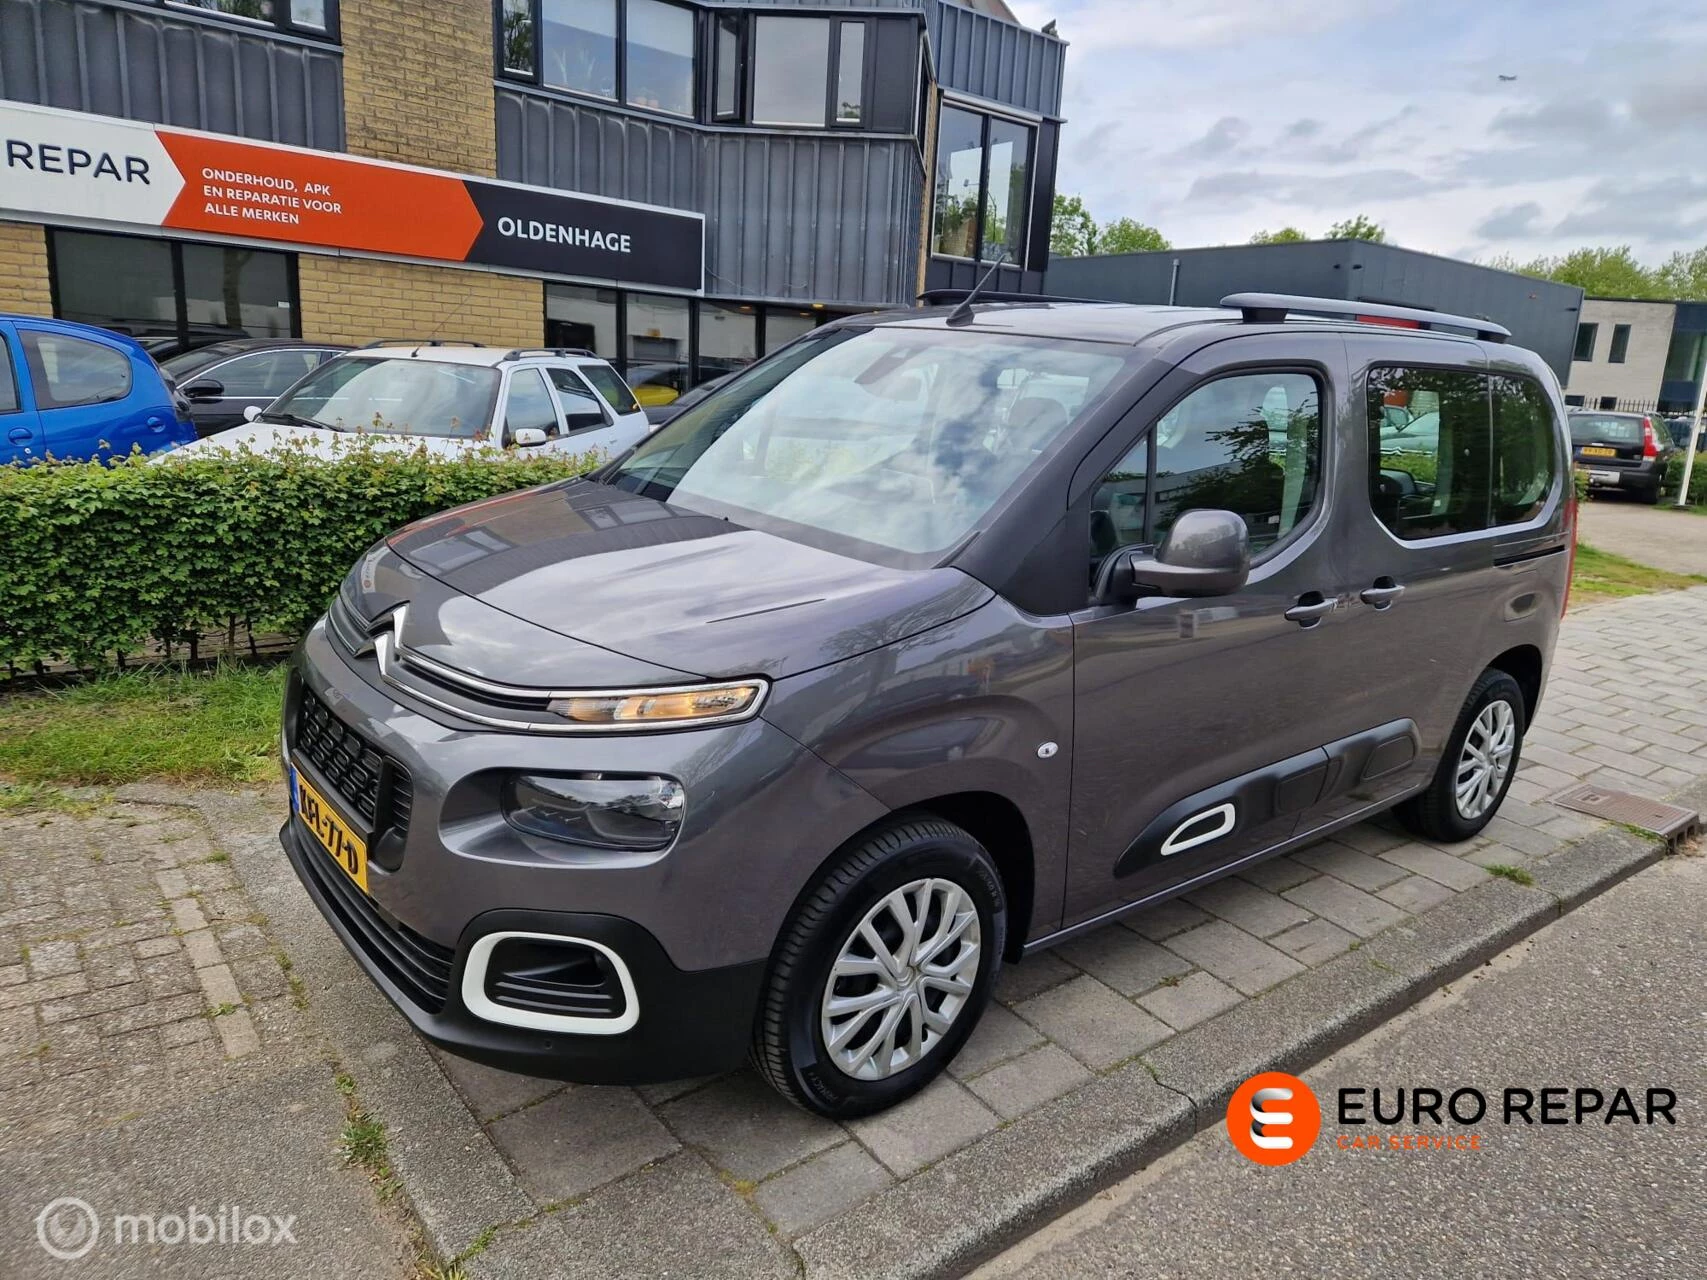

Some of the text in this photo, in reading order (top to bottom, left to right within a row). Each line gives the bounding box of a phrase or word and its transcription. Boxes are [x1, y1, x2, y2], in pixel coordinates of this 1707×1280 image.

[6, 139, 150, 185] REPAR
[202, 167, 331, 196] ONDERHOUD, APK
[203, 185, 342, 214] EN REPARATIE VOOR
[204, 203, 300, 225] ALLE MERKEN
[497, 216, 631, 253] OLDENHAGE
